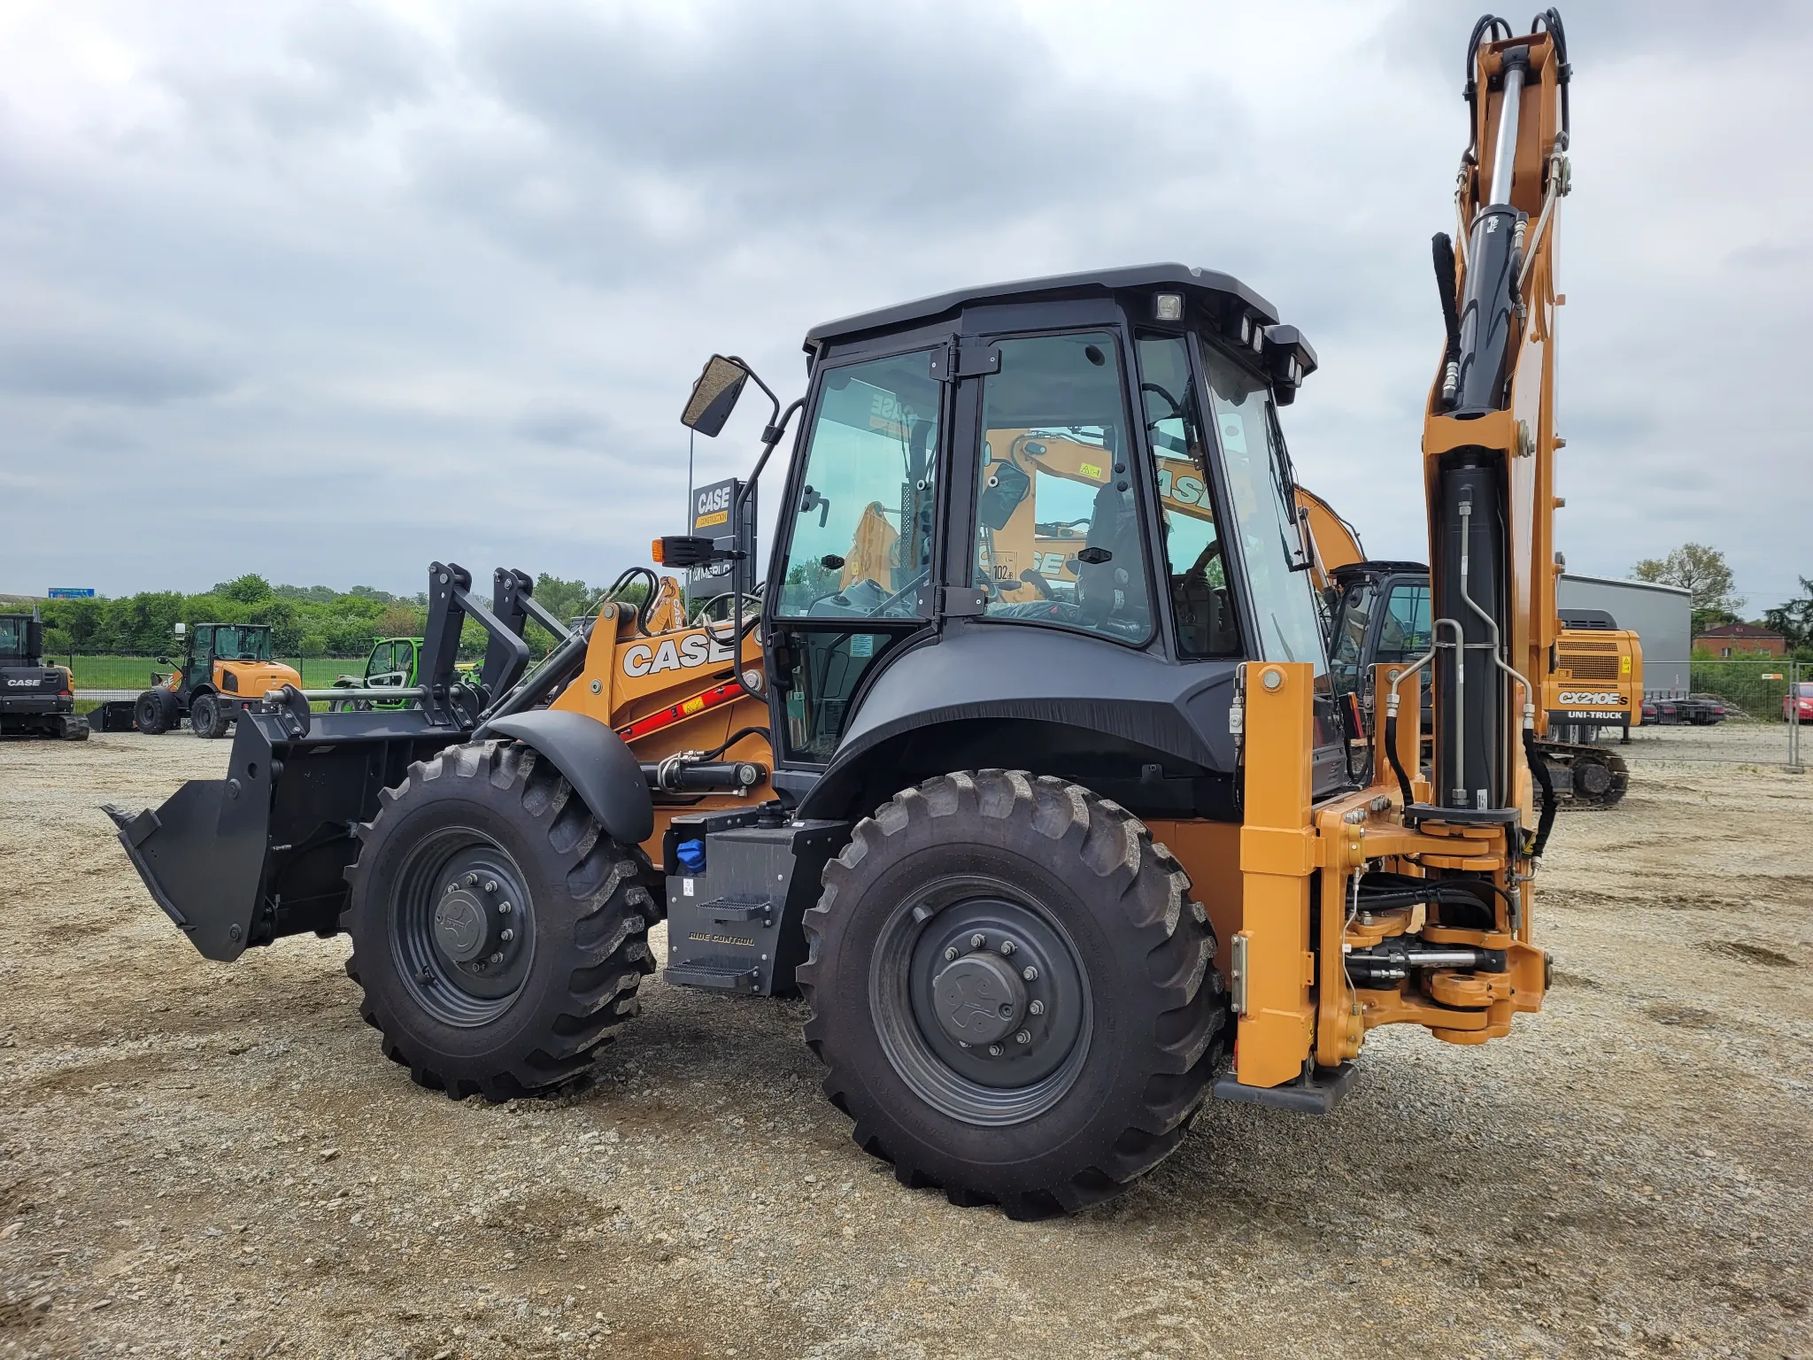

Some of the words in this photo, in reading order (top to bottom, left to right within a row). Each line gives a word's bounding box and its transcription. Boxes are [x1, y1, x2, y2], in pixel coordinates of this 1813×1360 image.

[1157, 468, 1211, 510] AS
[698, 487, 730, 514] CASE
[623, 633, 736, 677] CASE
[8, 679, 41, 687] CASE
[1568, 711, 1622, 719] UNI-TRUCK
[689, 932, 710, 941] RIDE
[712, 935, 754, 946] CONTROL
